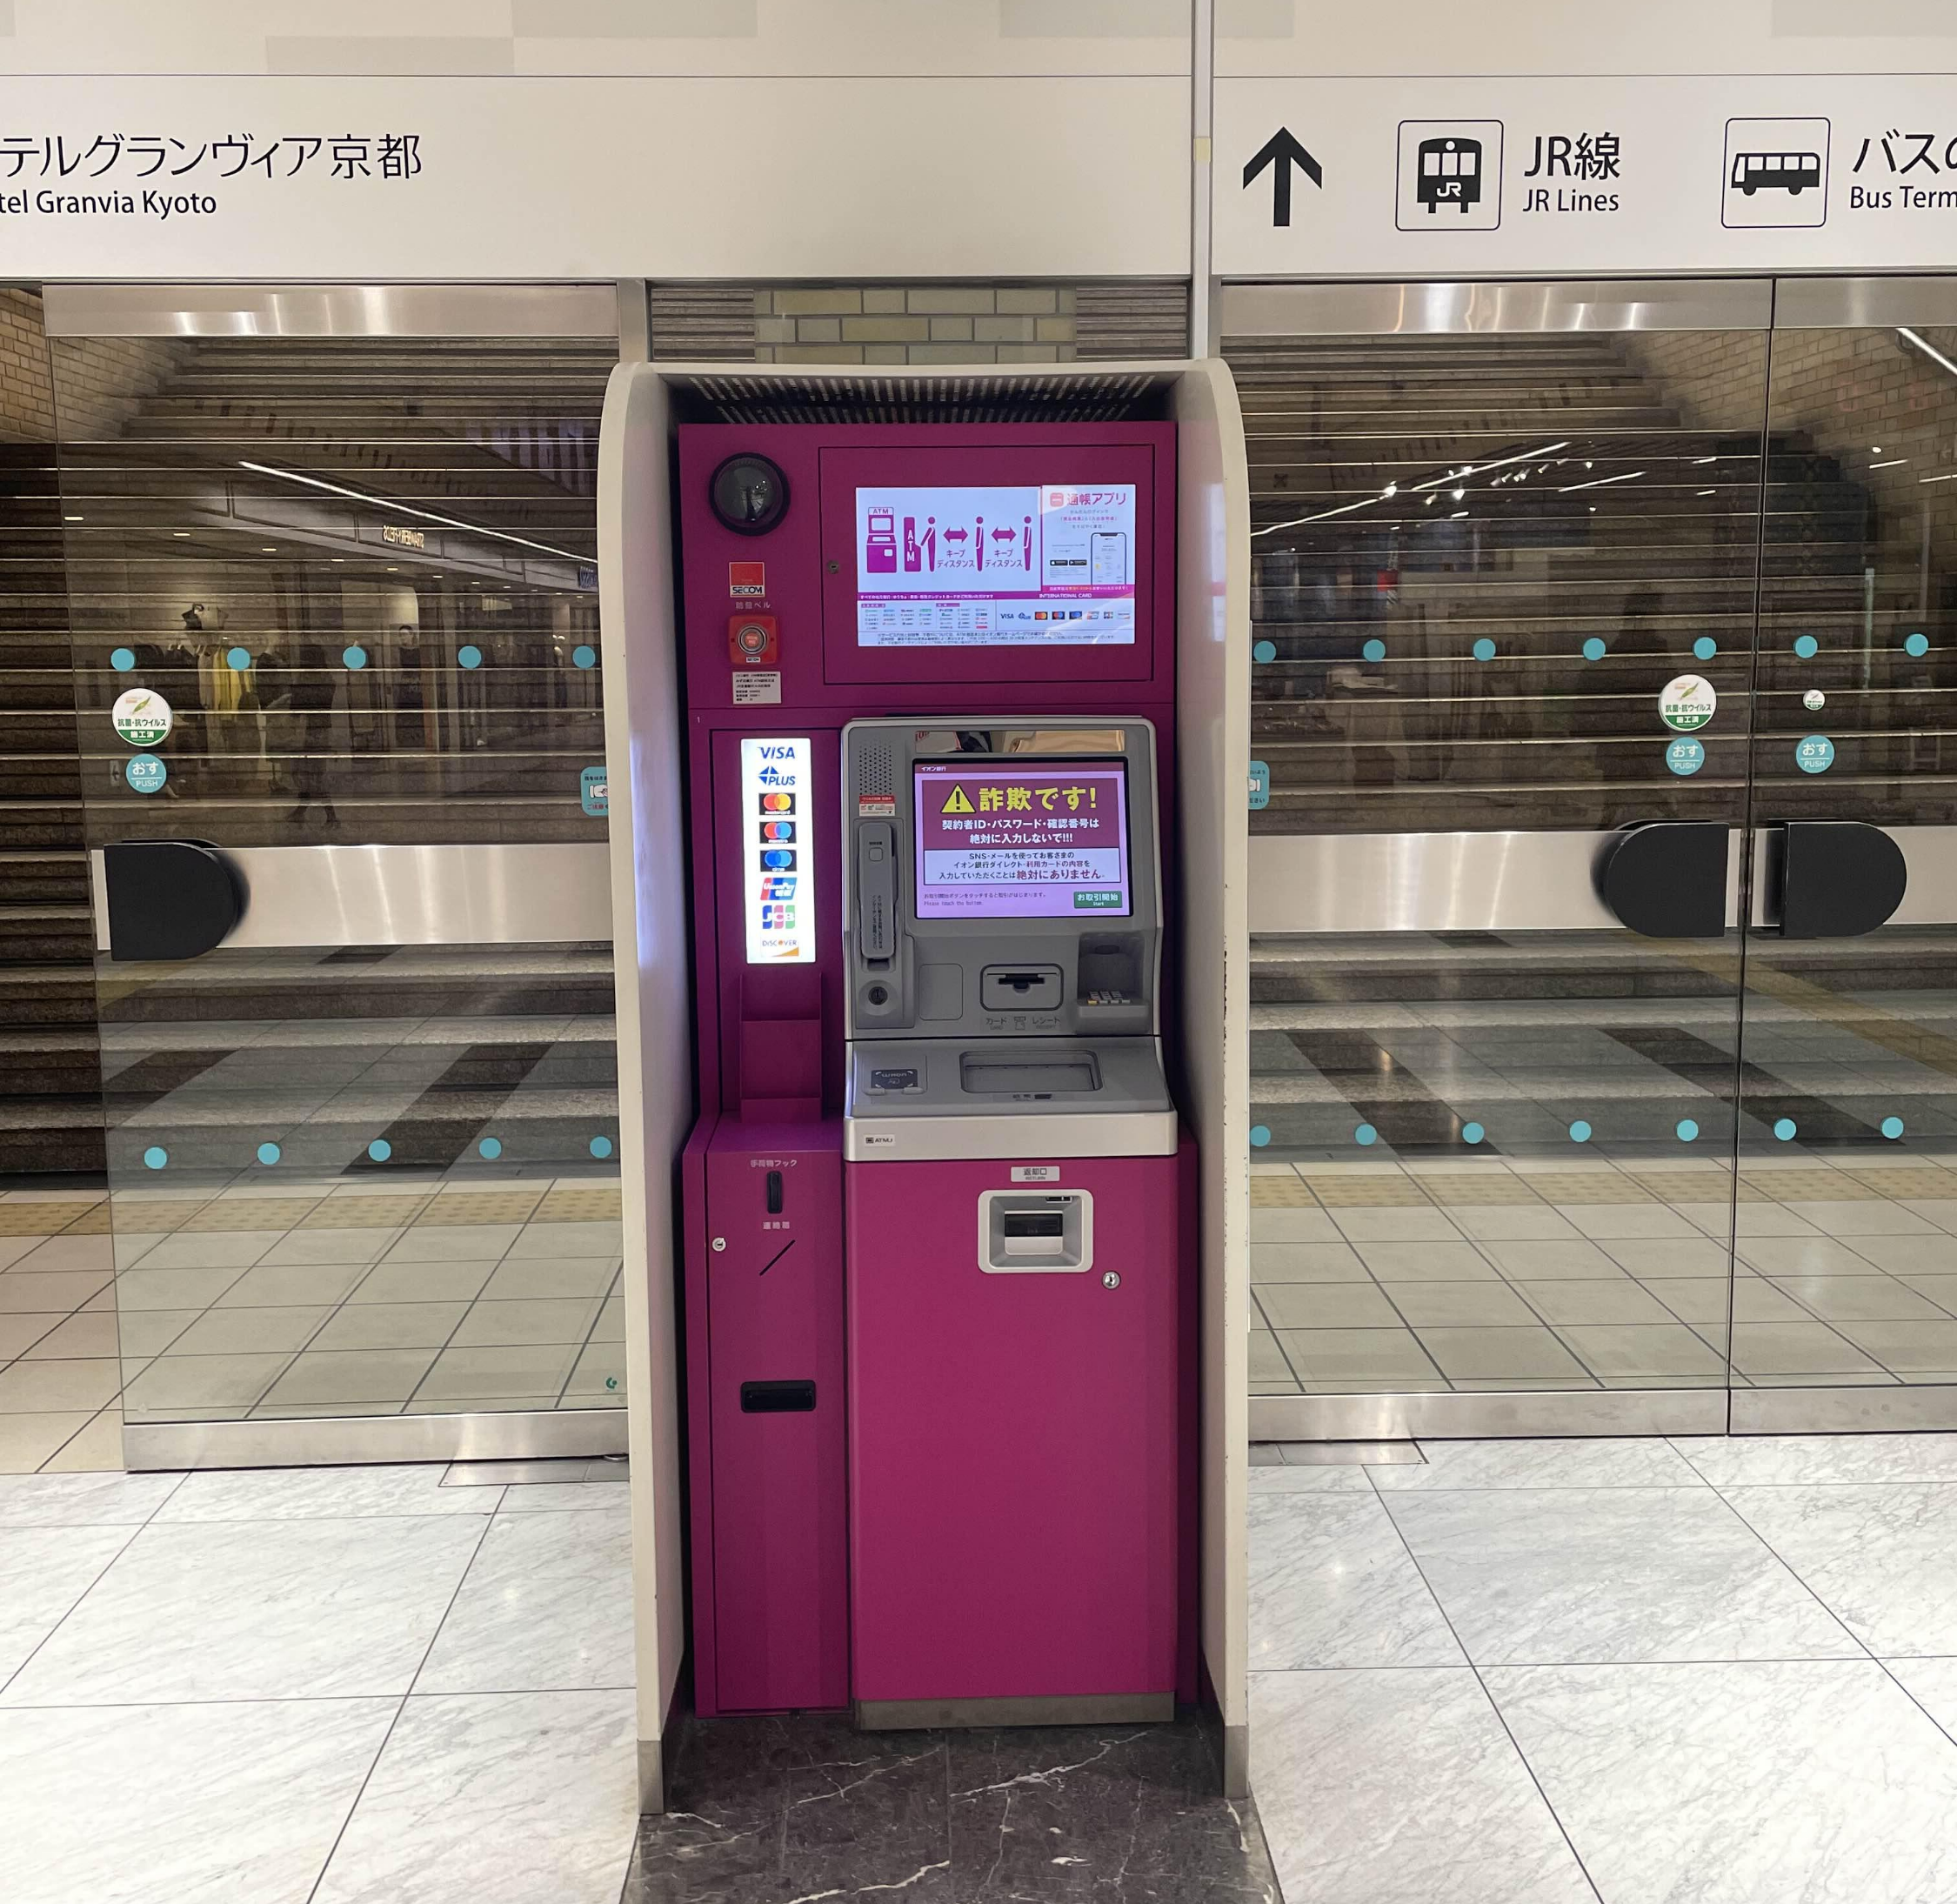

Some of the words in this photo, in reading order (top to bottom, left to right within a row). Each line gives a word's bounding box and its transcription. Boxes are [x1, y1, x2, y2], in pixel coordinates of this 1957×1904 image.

[1524, 131, 1621, 181] JR線
[1436, 182, 1462, 197] JR
[1850, 185, 1892, 209] Bus
[36, 190, 135, 214] Granvia
[143, 190, 217, 220] Kyoto
[1522, 190, 1550, 213] JR
[1558, 189, 1620, 213] Lines
[906, 530, 915, 562] ATM
[994, 549, 1013, 558] キープ
[758, 746, 796, 759] VISA
[1673, 745, 1699, 758] おす
[1802, 743, 1828, 757] おす
[132, 761, 159, 776] おす
[768, 776, 796, 785] PLUS
